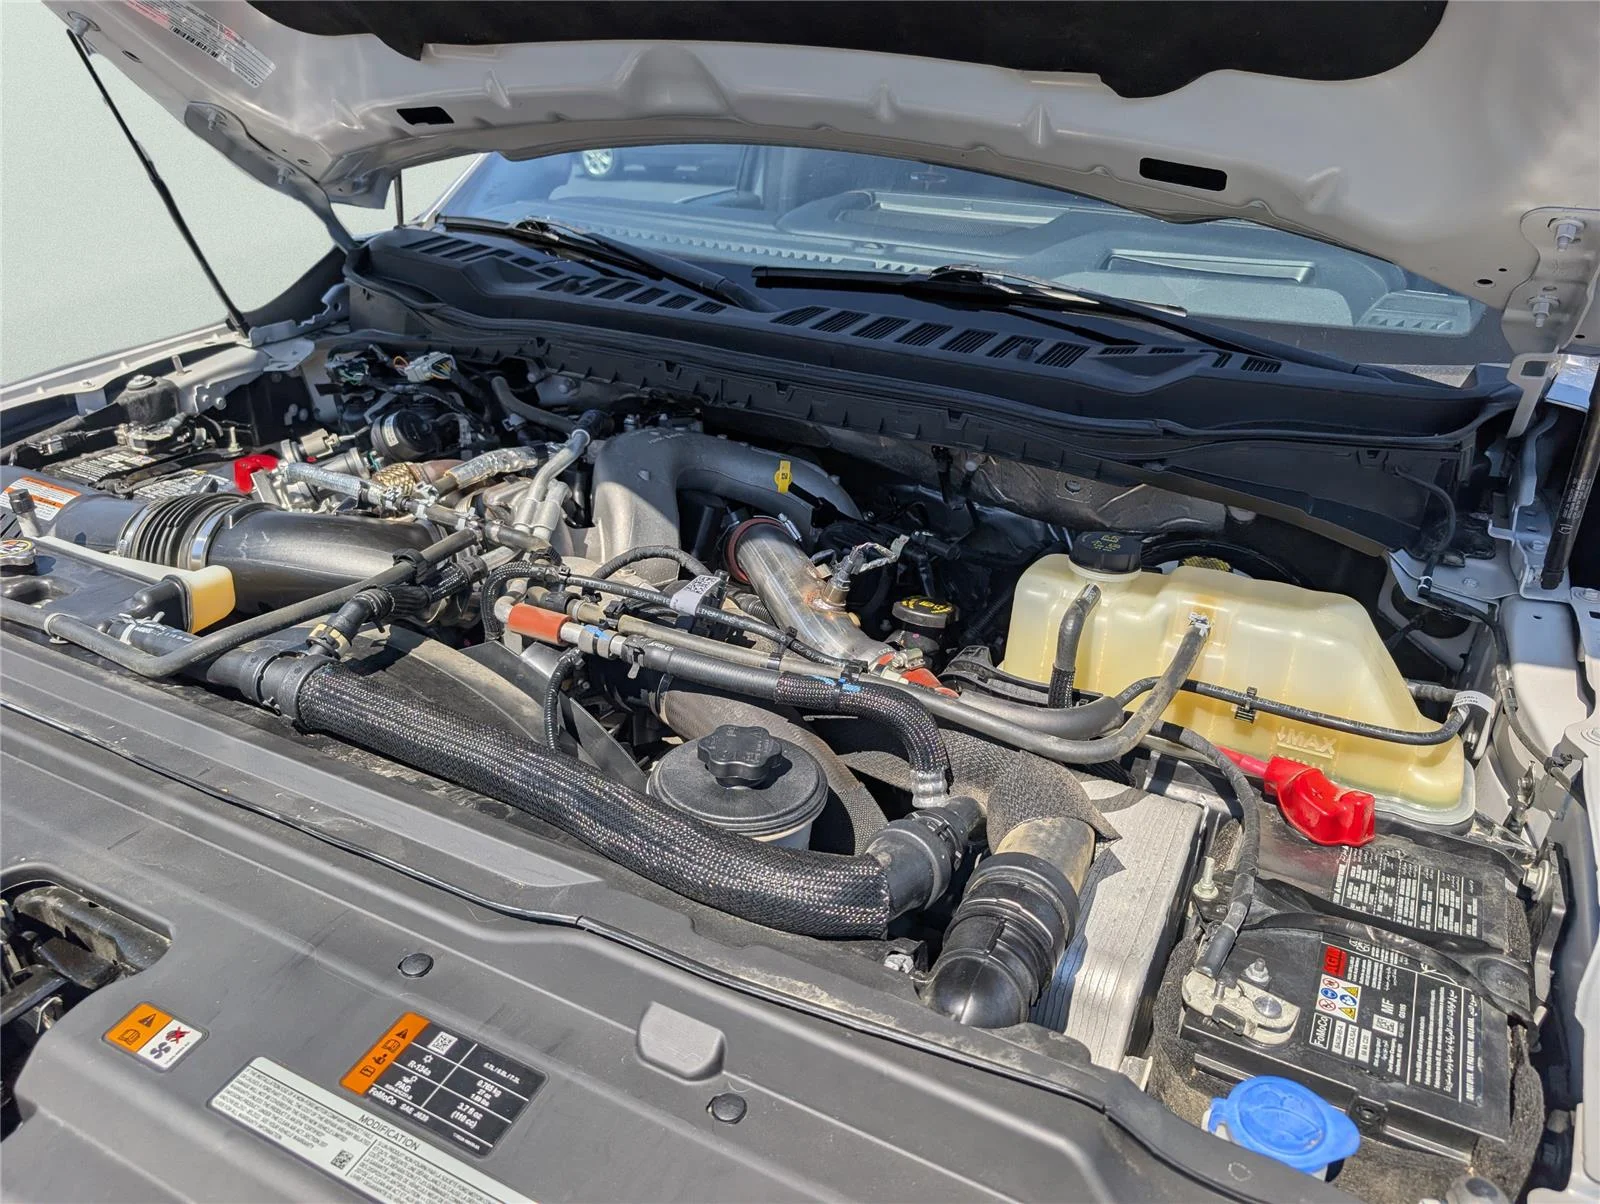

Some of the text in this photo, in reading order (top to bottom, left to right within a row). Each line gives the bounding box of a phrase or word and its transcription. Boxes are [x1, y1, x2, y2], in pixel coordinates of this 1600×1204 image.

[1286, 728, 1337, 755] MAX
[1324, 945, 1340, 974] AGM
[1380, 997, 1395, 1015] MF
[1313, 1014, 1328, 1046] FoMoCo
[406, 1059, 433, 1076] R-134a
[394, 1080, 412, 1092] PAG
[367, 1086, 398, 1105] FoMoCo
[398, 1103, 415, 1114] SAE
[456, 1102, 470, 1112] 3.7
[358, 1114, 421, 1151] MODIFICATION
[462, 1117, 479, 1129] cc)
